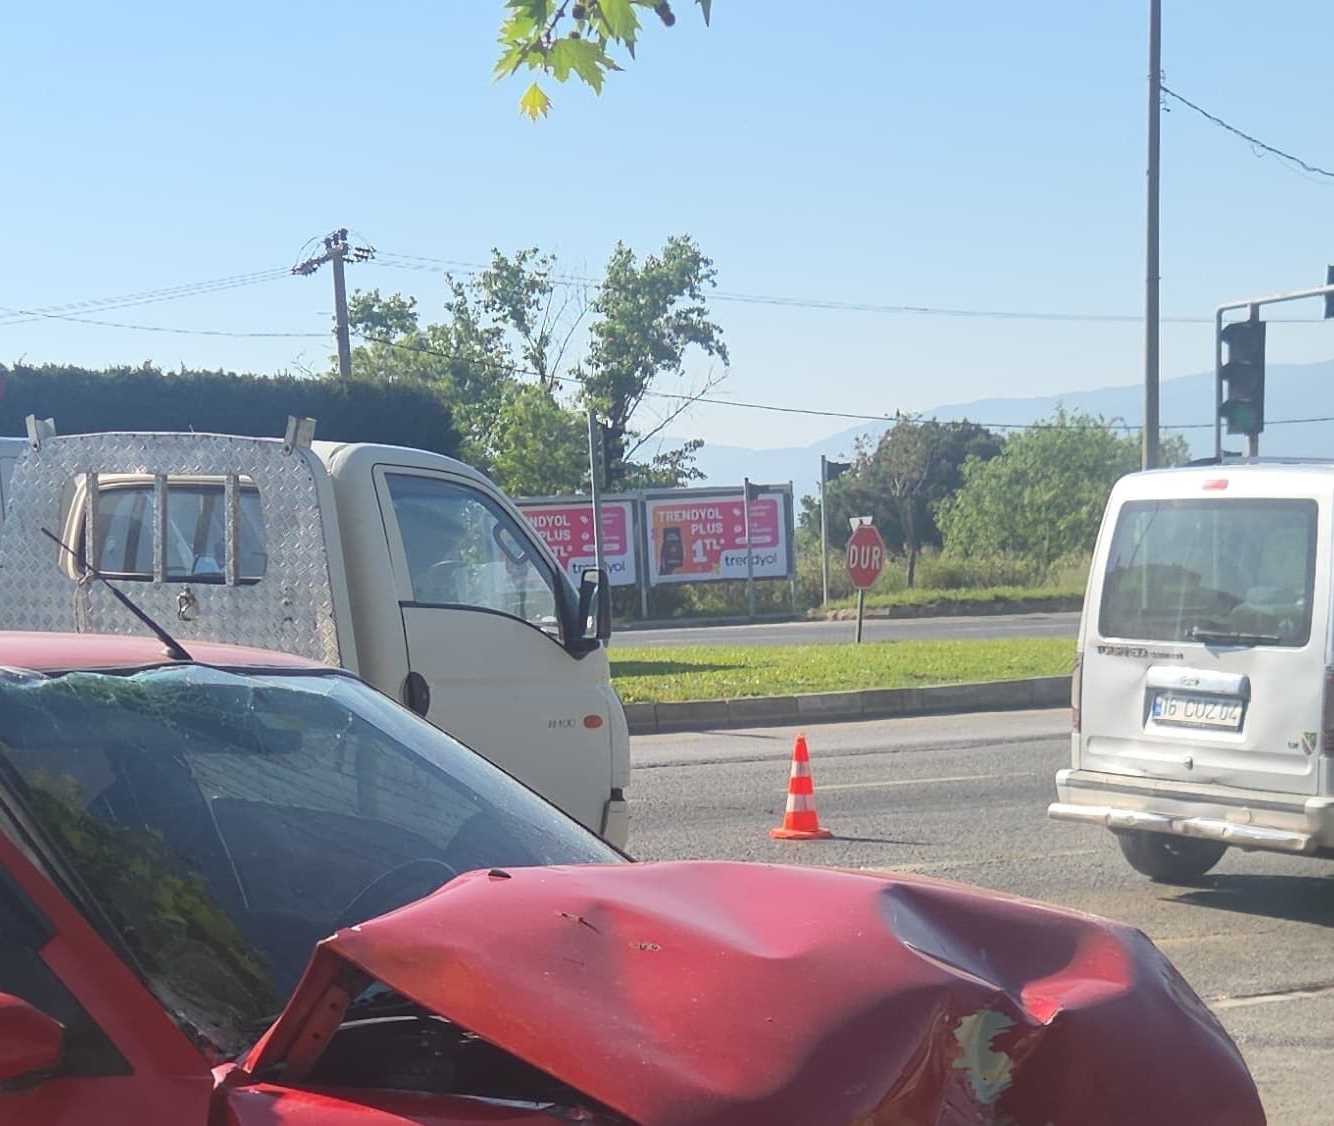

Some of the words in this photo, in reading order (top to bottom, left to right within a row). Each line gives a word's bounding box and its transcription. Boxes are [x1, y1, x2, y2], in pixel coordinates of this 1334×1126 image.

[529, 515, 571, 528] NDYOL
[658, 507, 723, 523] TRENDYOL
[690, 522, 723, 536] PLUS
[849, 544, 881, 570] DUR
[572, 560, 626, 575] tryol
[1163, 696, 1177, 716] 16
